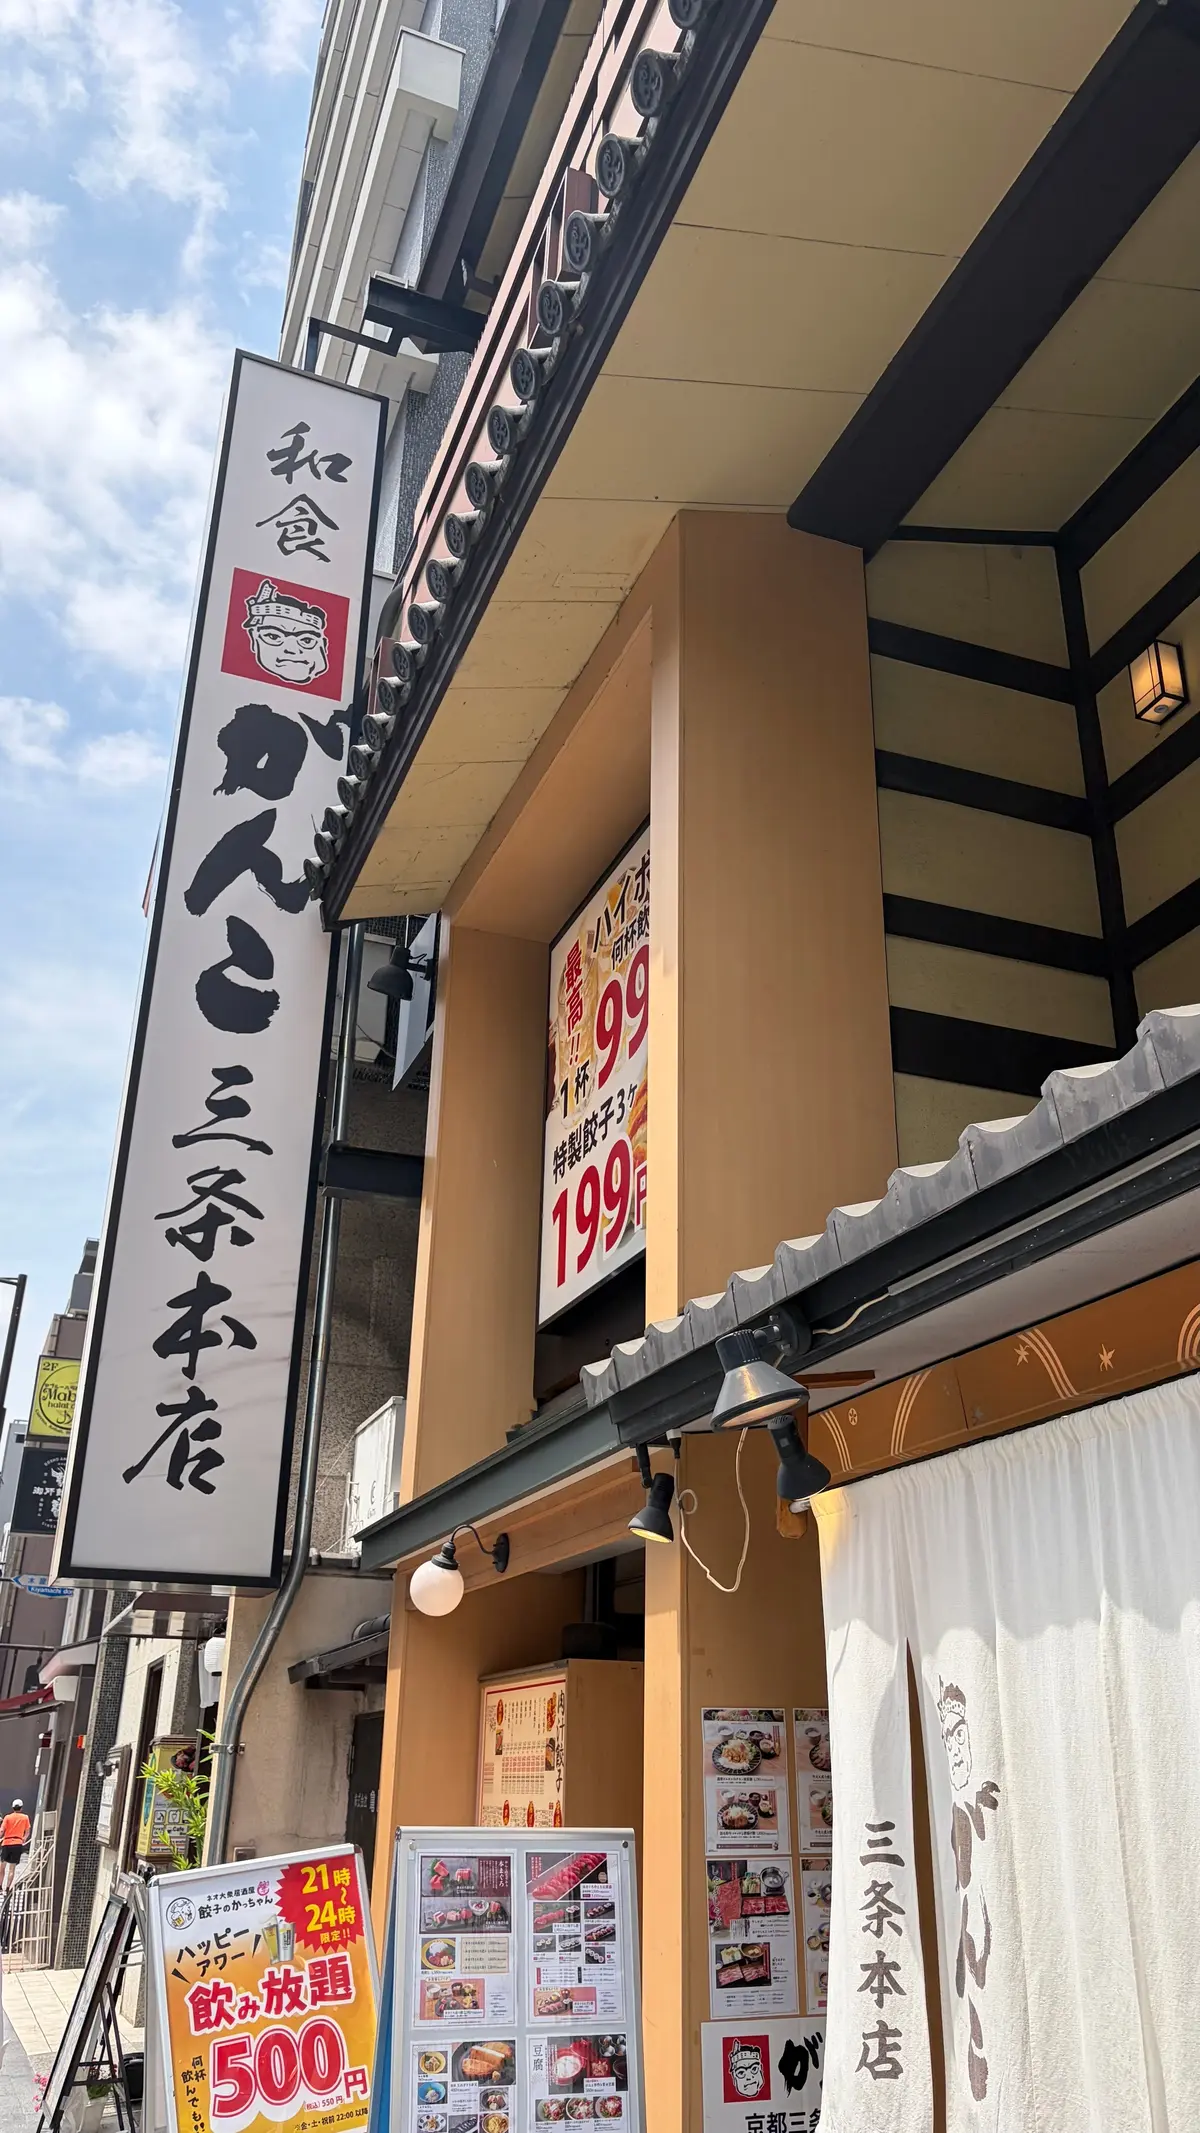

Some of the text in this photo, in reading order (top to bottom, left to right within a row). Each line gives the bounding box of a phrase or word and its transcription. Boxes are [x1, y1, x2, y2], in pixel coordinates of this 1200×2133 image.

[256, 421, 353, 563] 和食
[123, 703, 353, 1495] がんこ 三条本店
[42, 1361, 59, 1372] 2F
[31, 1586, 62, 1594] Kiyamachi
[207, 1886, 256, 1902] ネオ大衆居酒屋
[300, 1863, 351, 1895] 21時
[198, 1895, 274, 1920] 餃子のかっちゃん
[305, 1900, 356, 1933] 24時
[176, 1927, 250, 1964] ハッピー
[854, 1820, 907, 2081] 三条本店
[196, 1952, 245, 1978] アワー
[188, 1955, 353, 2032] 飲み放題
[212, 2018, 368, 2118] 500円
